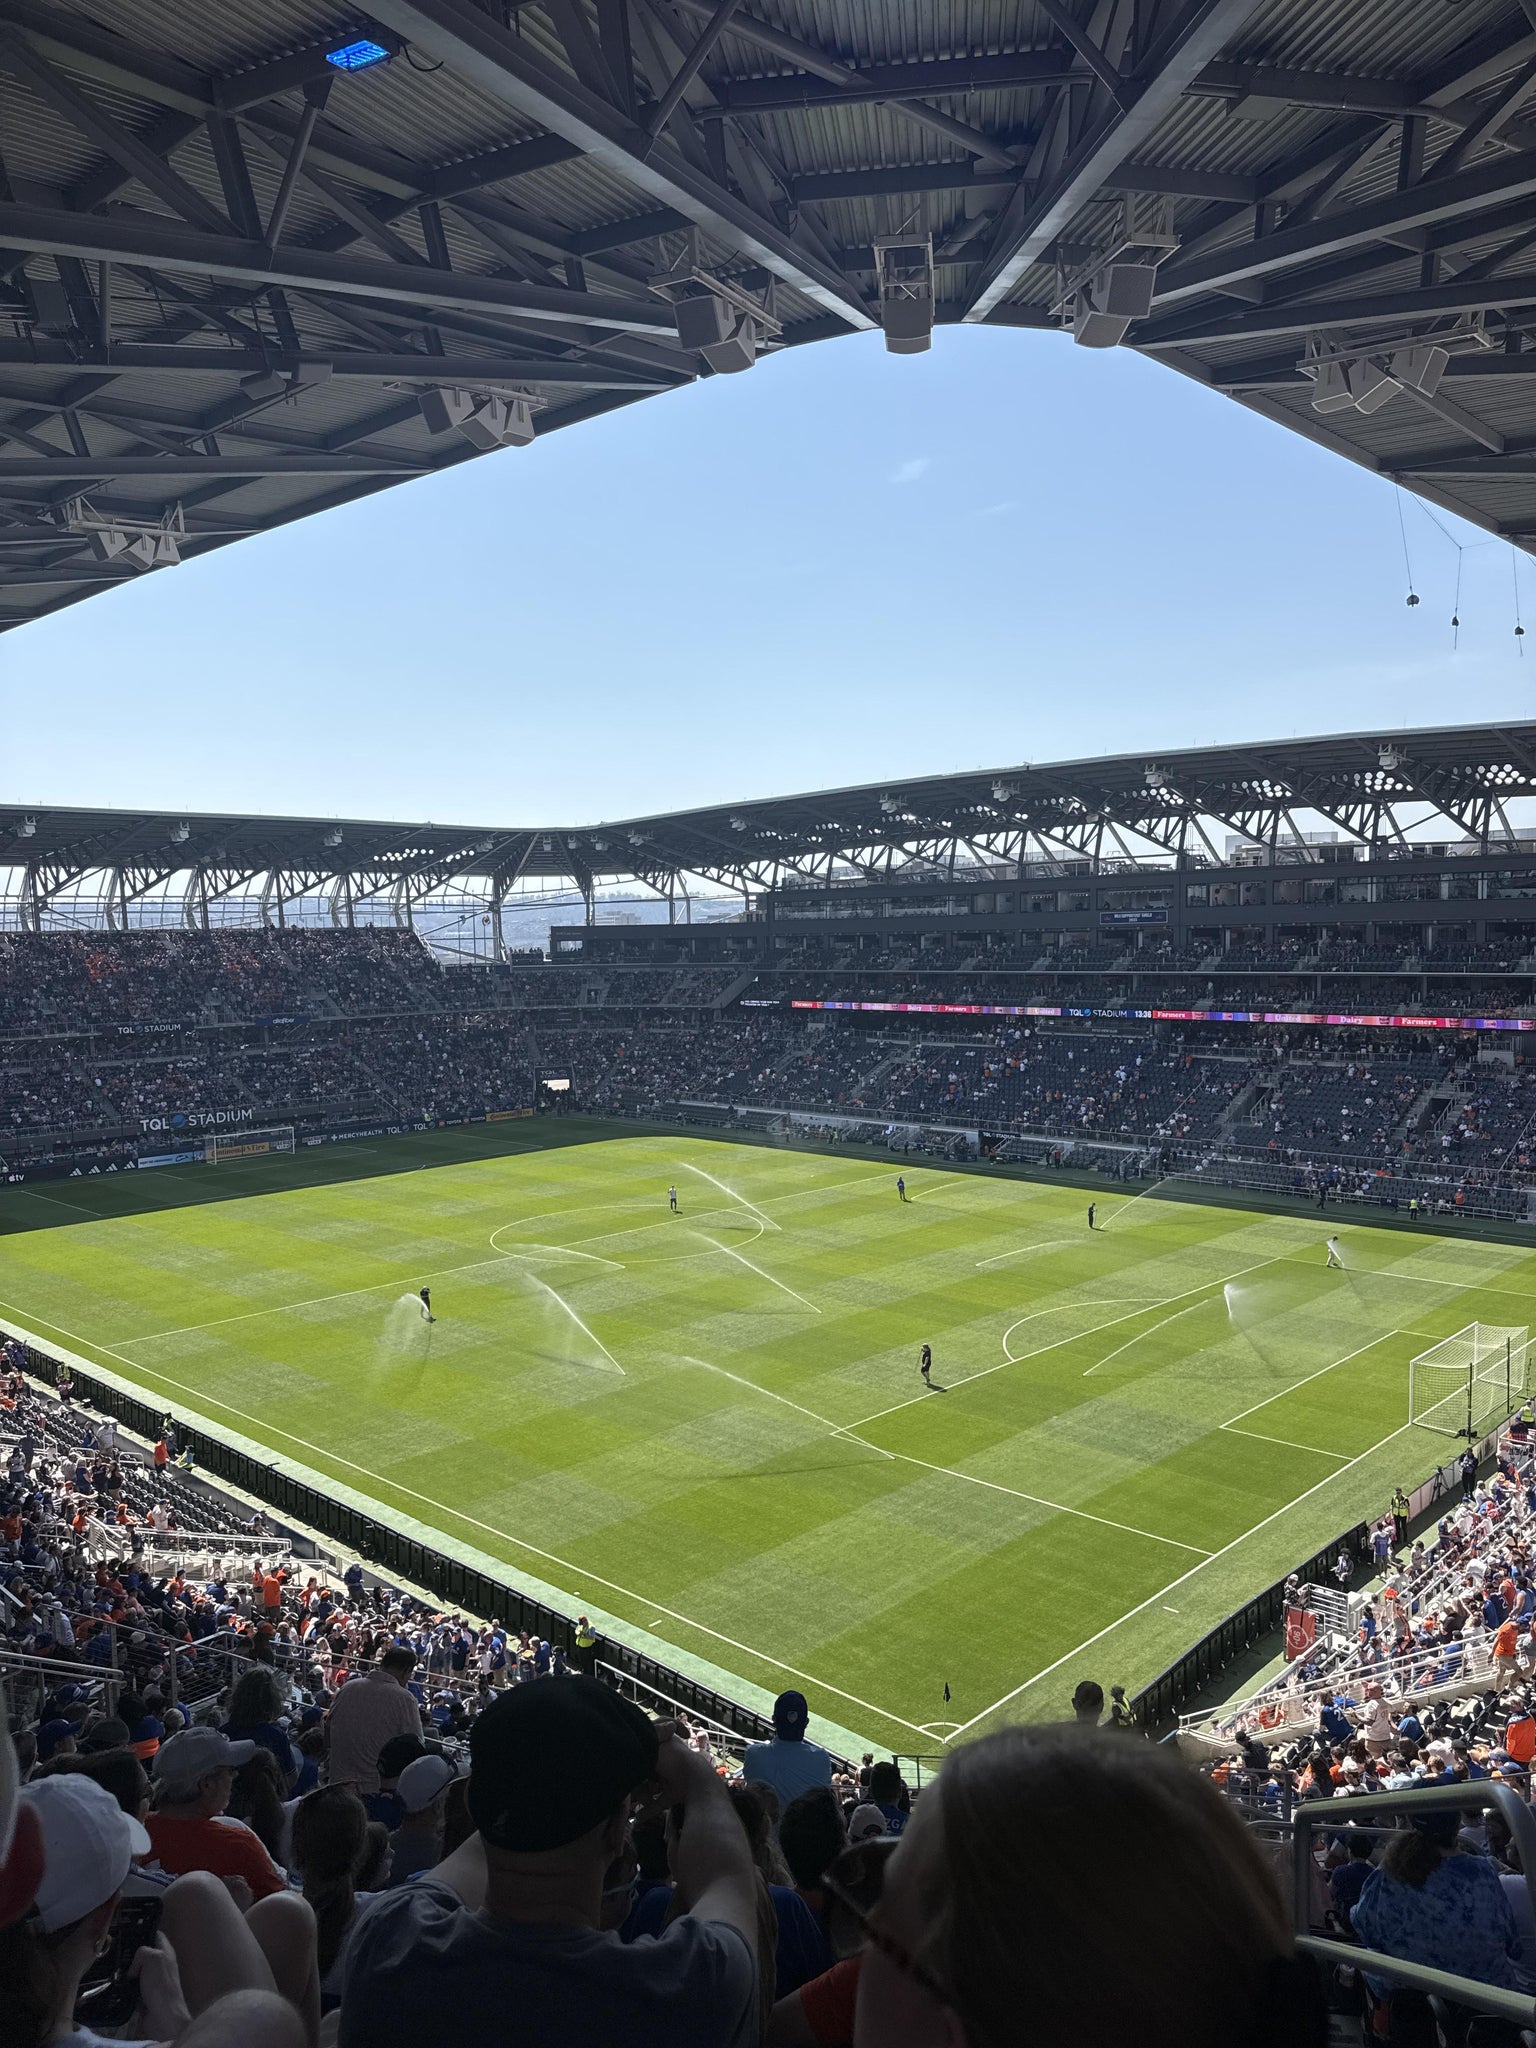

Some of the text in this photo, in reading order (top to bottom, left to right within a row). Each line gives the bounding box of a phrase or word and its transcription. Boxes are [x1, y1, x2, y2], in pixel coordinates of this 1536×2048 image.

[1069, 1008, 1128, 1018] TQL STADIUM
[1157, 1011, 1186, 1019] Farmers
[1275, 1013, 1438, 1026] United Dairy Farmers
[118, 1023, 181, 1035] TQL STADIUM
[140, 1109, 253, 1131] TQL STADIUM
[386, 1126, 402, 1135] TQL
[413, 1123, 428, 1131] TQL
[338, 1129, 383, 1140] MERCYHEALTH
[251, 1143, 266, 1153] Tire
